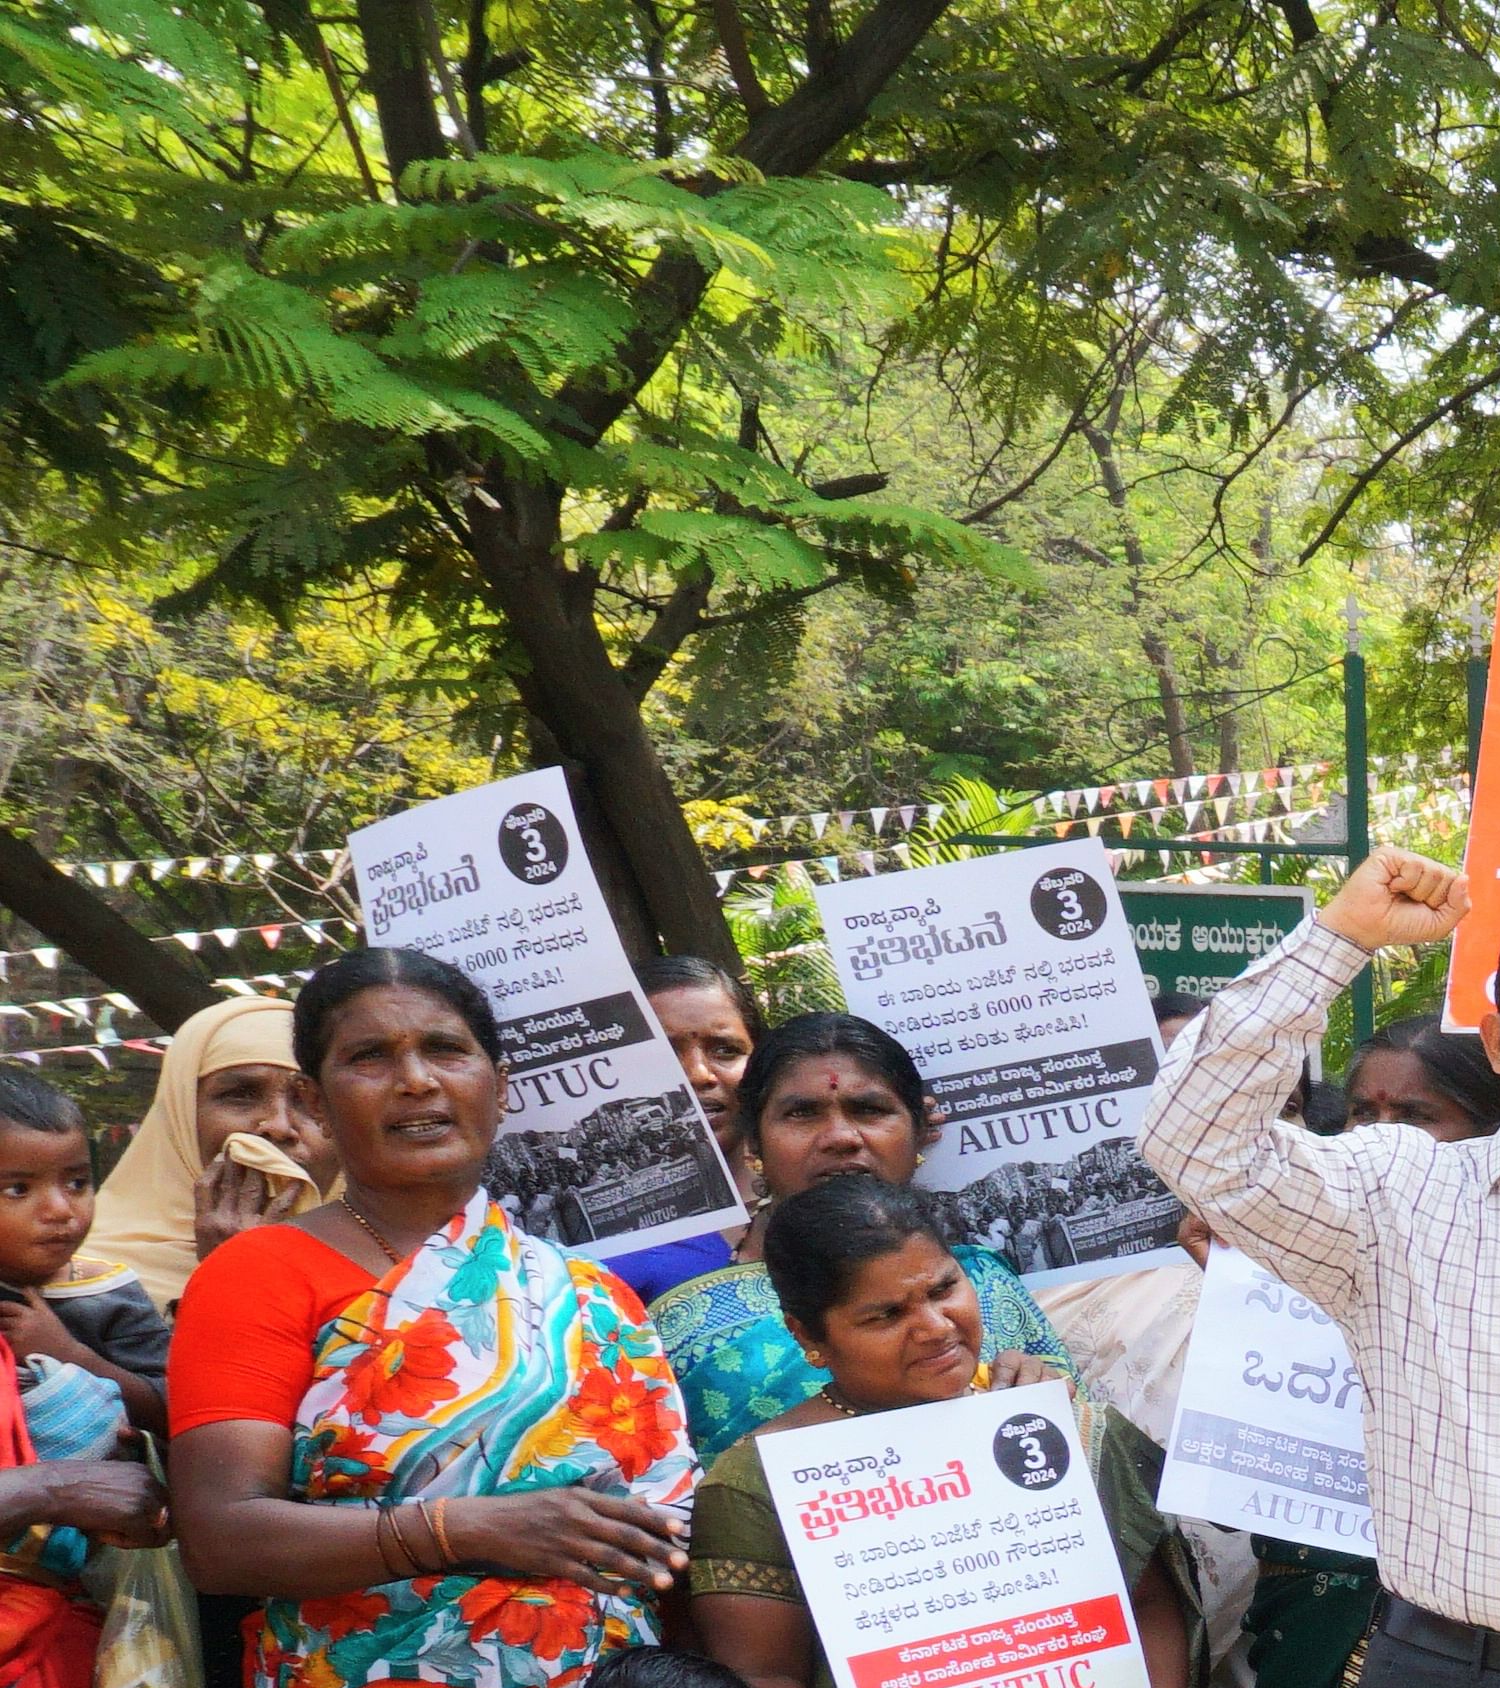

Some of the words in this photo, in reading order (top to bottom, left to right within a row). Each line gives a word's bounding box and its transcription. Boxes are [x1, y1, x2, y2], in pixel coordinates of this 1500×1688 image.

[521, 829, 547, 862] 3
[524, 861, 557, 879] 2024
[370, 853, 481, 936] ಪ್ರತಿಭಟನೆ
[1057, 890, 1083, 920] 3
[843, 898, 942, 932] ರಾಜ್ಯವ್ಯಾಪಿ
[1058, 919, 1093, 935] 2024
[465, 946, 509, 973] 6000
[847, 911, 1007, 981] ಪ್ರತಿಭಟನೆ
[986, 994, 1033, 1018] 6000
[907, 1038, 953, 1067] ಚ್ಚಳದ
[506, 1057, 619, 1114] UTUC
[931, 1069, 998, 1095] ಕರ್ನಾಟಕ
[1000, 1065, 1041, 1083] ರಾಜ್ಯ
[1041, 1050, 1106, 1074] ಸಂಯುಕ್ತ
[1096, 1065, 1138, 1086] ಸಂಘ
[958, 1095, 1122, 1155] AIUTUC
[792, 1446, 902, 1486] ರಾಜ್ಯವ್ಯಾಪಿ
[1019, 1436, 1047, 1469] 3
[1022, 1467, 1057, 1485] 2024
[1313, 1471, 1369, 1496] ಕಾರ್ಮಿ
[796, 1459, 973, 1542] ಪ್ರತಿಭಟನೆ
[931, 1518, 983, 1548] ಬಜೆಟ್
[989, 1512, 1026, 1537] ನಲ್ಲಿ
[1025, 1497, 1083, 1529] ಭರವಸೆ
[843, 1559, 948, 1601] ನೀಡಿರುವಂತೆ
[952, 1550, 1001, 1575] 6000
[853, 1599, 920, 1633] ಹೆಚ್ಚಳದ
[924, 1588, 978, 1615] ಕುರಿತು
[898, 1633, 969, 1663] ಕರ್ನಾಟಕ
[971, 1628, 1013, 1647] ರಾಜ್ಯ
[1012, 1608, 1078, 1637] ಸಂಯುಕ್ತ
[923, 1653, 997, 1683] ದಾಸೋಹ
[998, 1634, 1069, 1665] ಕಾರ್ಮಿಕರ
[1070, 1625, 1108, 1647] ಸಂಘ
